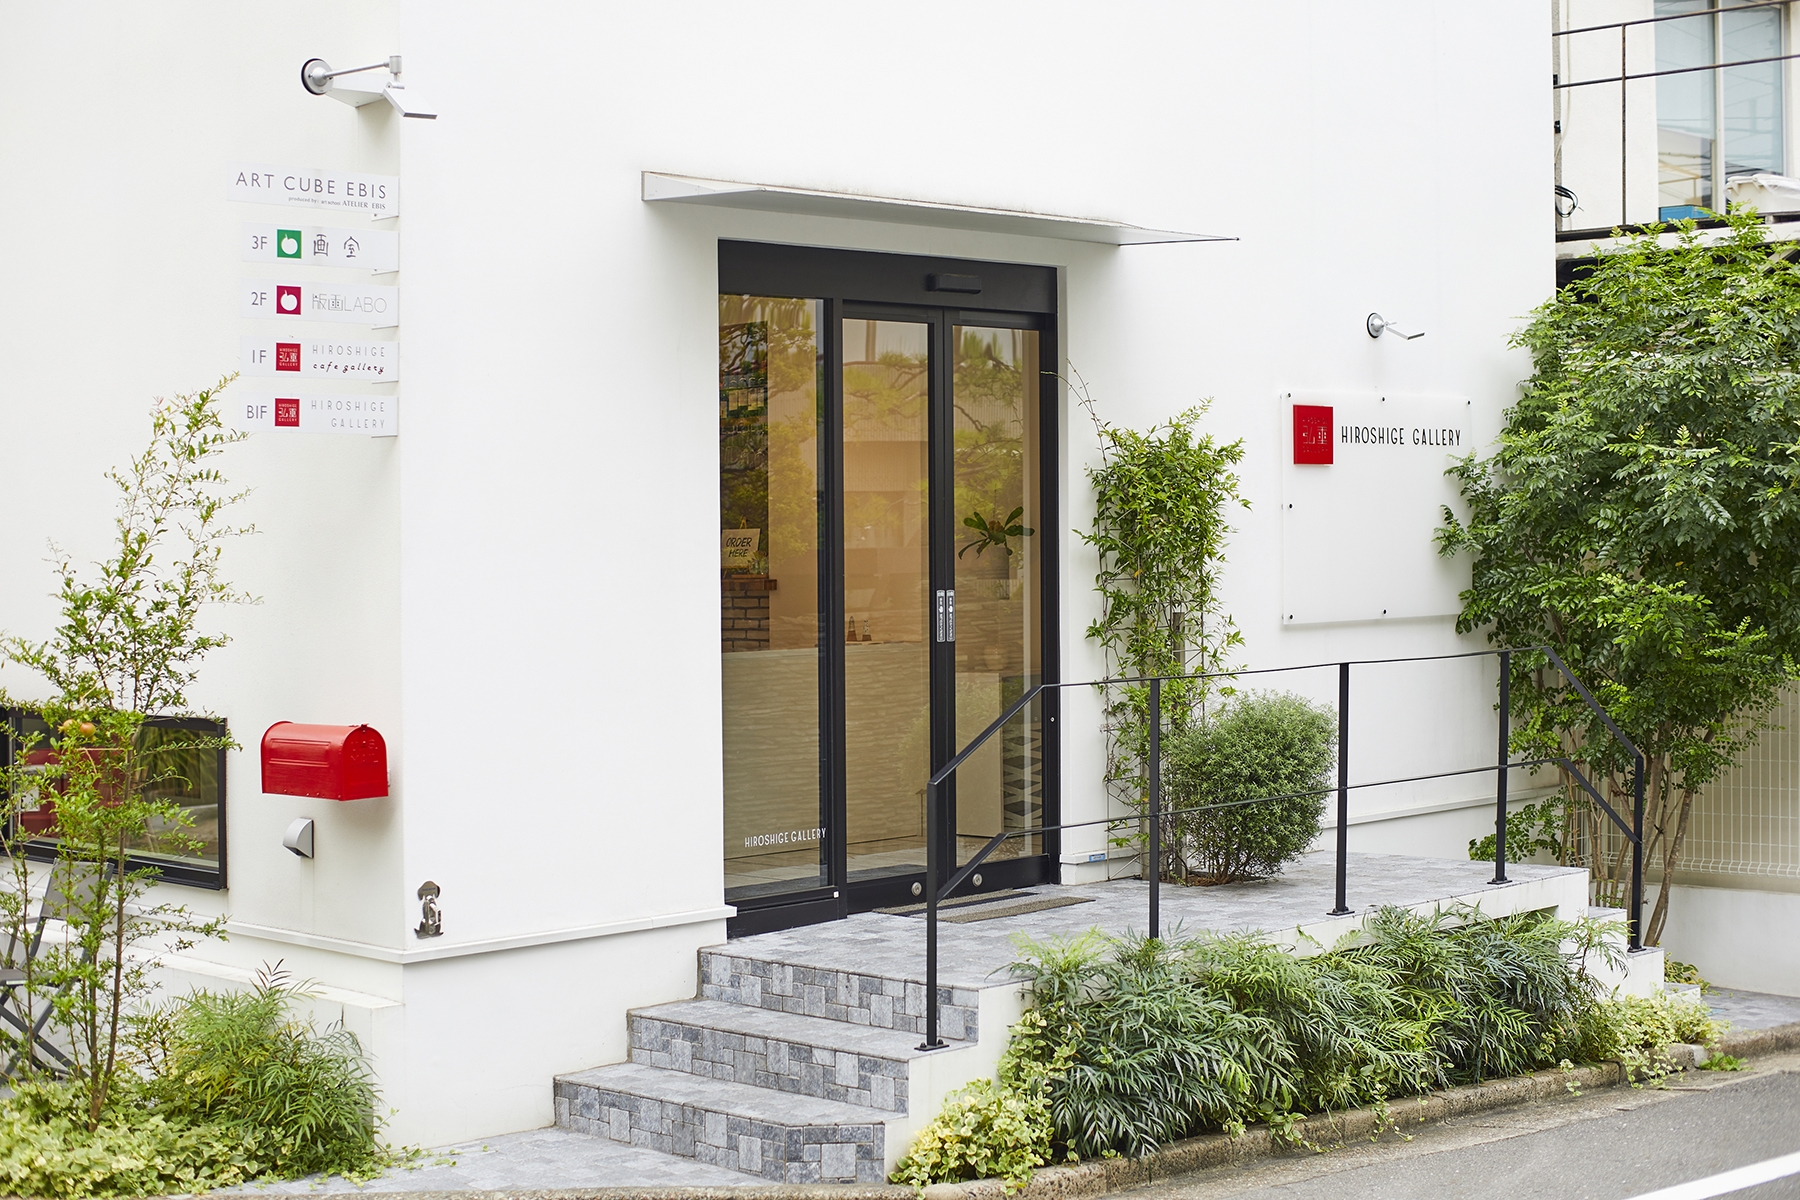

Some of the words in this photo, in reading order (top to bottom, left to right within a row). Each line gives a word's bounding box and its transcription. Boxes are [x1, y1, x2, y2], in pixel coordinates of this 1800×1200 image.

[235, 172, 274, 188] ART
[283, 176, 335, 195] CUBE
[347, 181, 386, 200] EBIS
[342, 200, 368, 209] ATELIER
[371, 202, 386, 210] EBIS
[252, 235, 268, 250] 3F
[251, 291, 268, 306] 2F
[252, 349, 267, 364] 1F
[312, 344, 385, 358] HIROSHIGE
[312, 361, 339, 372] cafe
[342, 362, 385, 375] gallery
[246, 404, 268, 420] B1F
[311, 400, 385, 412] HIROSHIGE
[331, 417, 385, 429] GALLERY
[1341, 425, 1405, 445] HIROSHIGE
[1412, 428, 1461, 446] GALLERY
[725, 537, 752, 547] ORDER
[728, 549, 748, 558] HERE
[744, 831, 789, 848] HIROSHIGE
[790, 827, 827, 842] GALLERY
